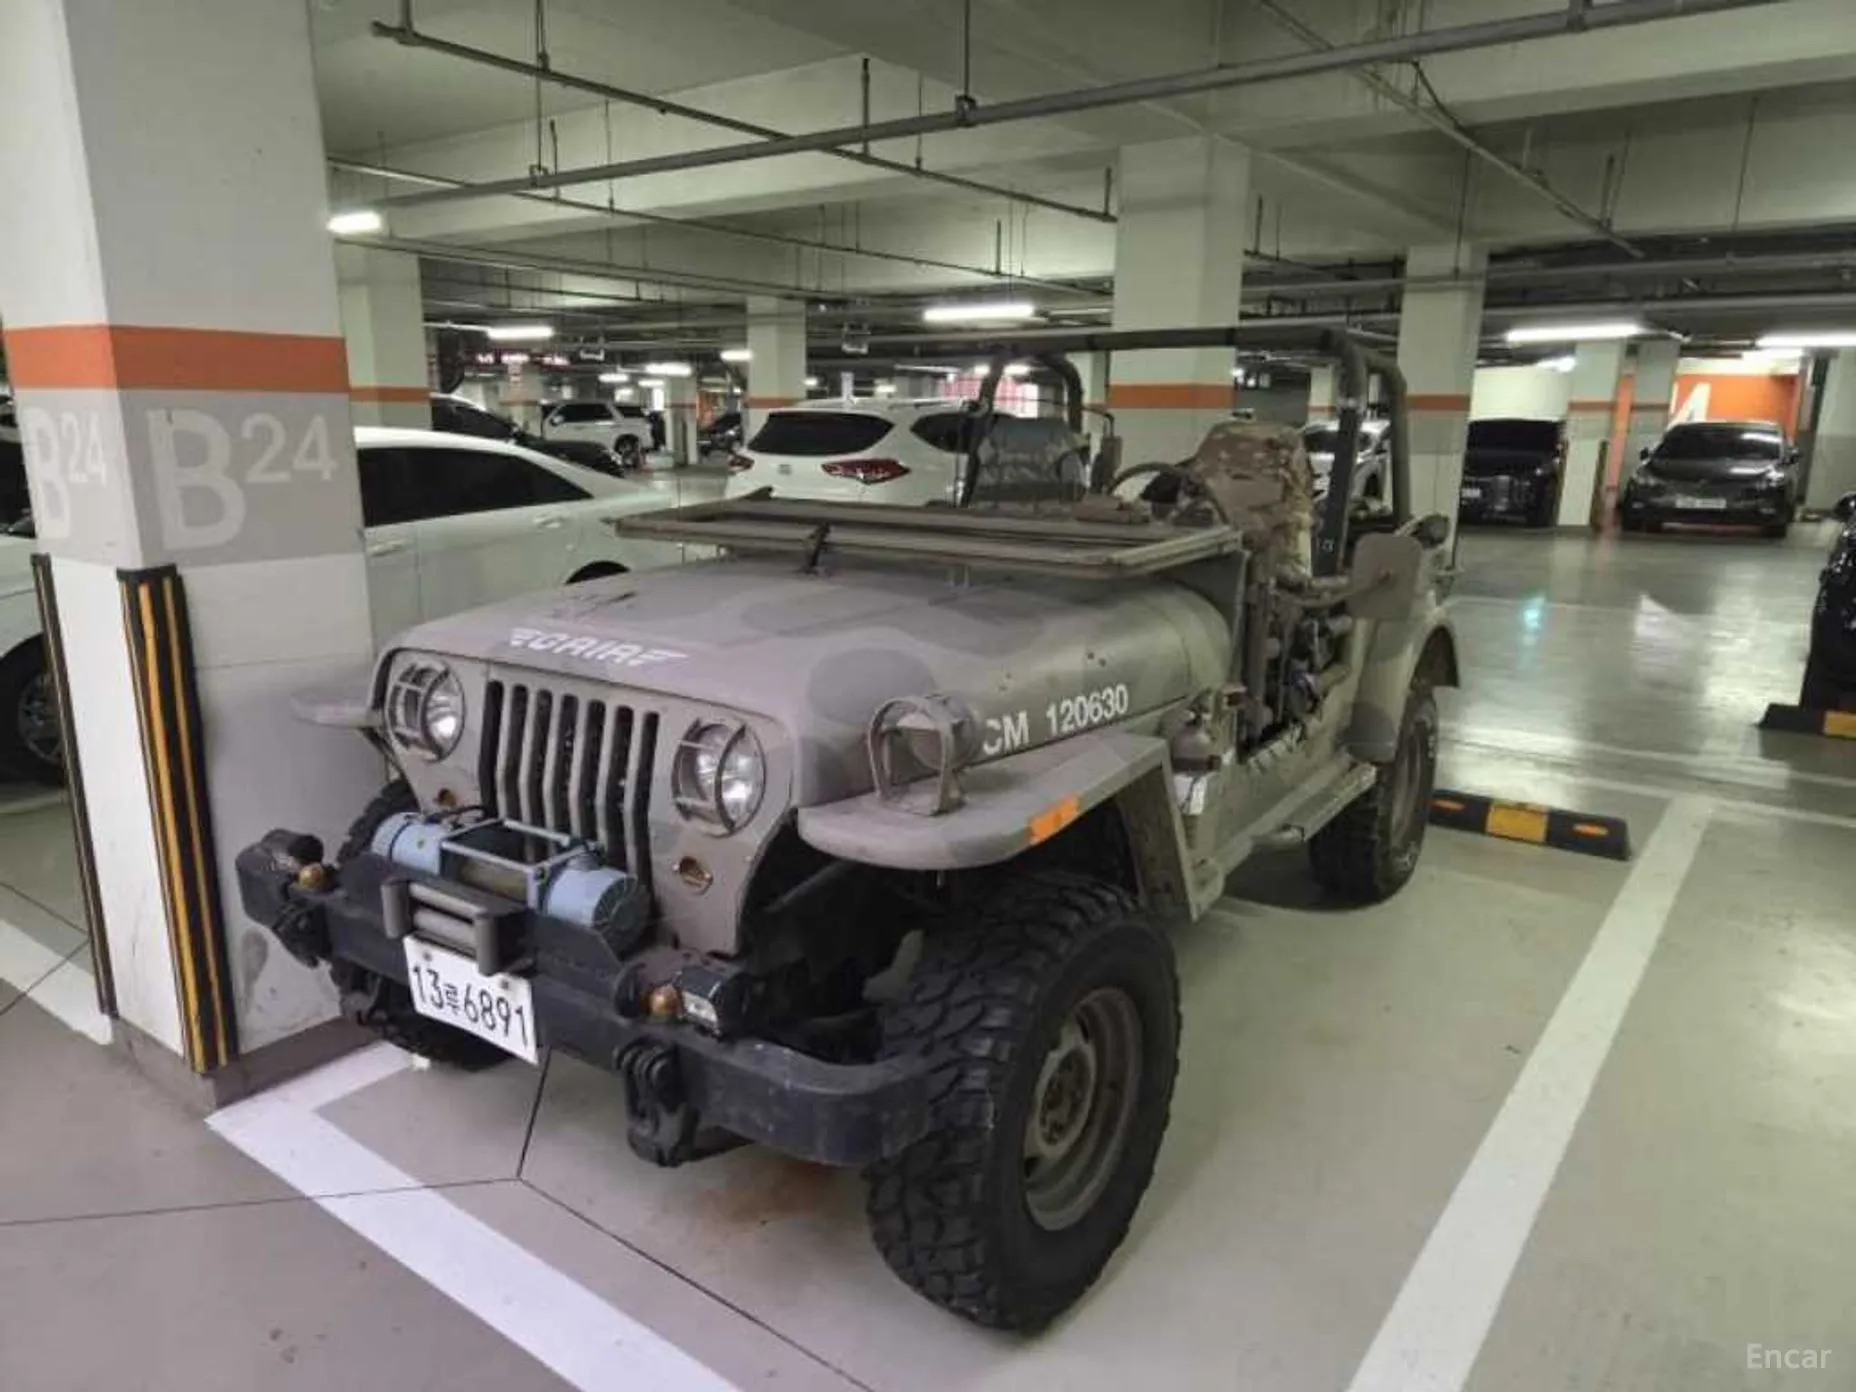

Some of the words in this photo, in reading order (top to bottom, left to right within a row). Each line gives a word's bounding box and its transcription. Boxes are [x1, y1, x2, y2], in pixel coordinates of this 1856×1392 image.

[20, 406, 107, 539] B24
[145, 408, 337, 550] B24
[1046, 683, 1129, 736] 120630
